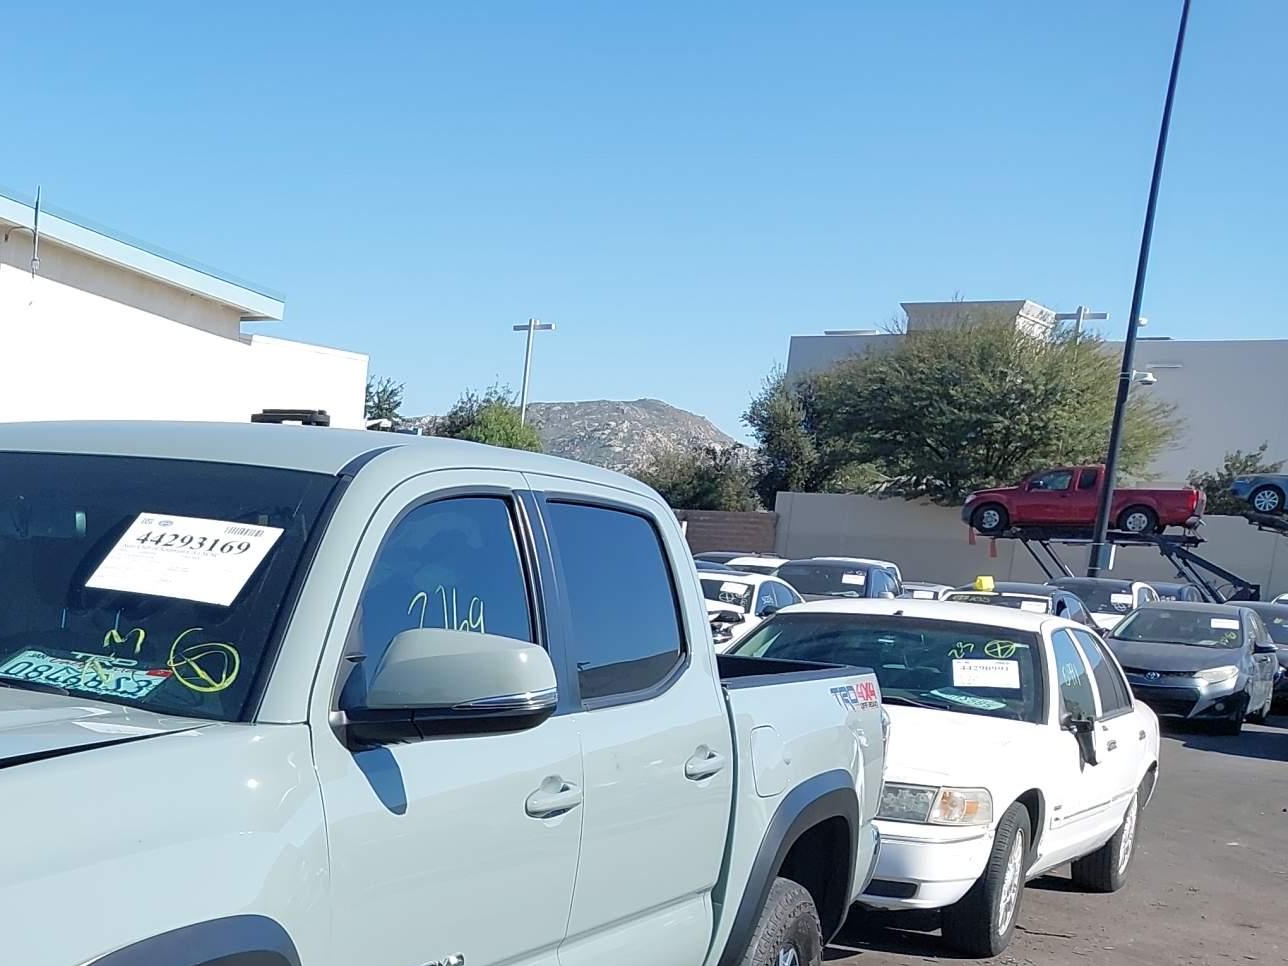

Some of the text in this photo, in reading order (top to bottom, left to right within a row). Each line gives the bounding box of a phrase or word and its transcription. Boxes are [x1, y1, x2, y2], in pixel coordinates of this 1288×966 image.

[136, 530, 251, 555] 44293169
[70, 650, 139, 667] TRD
[830, 685, 858, 711] TRD
